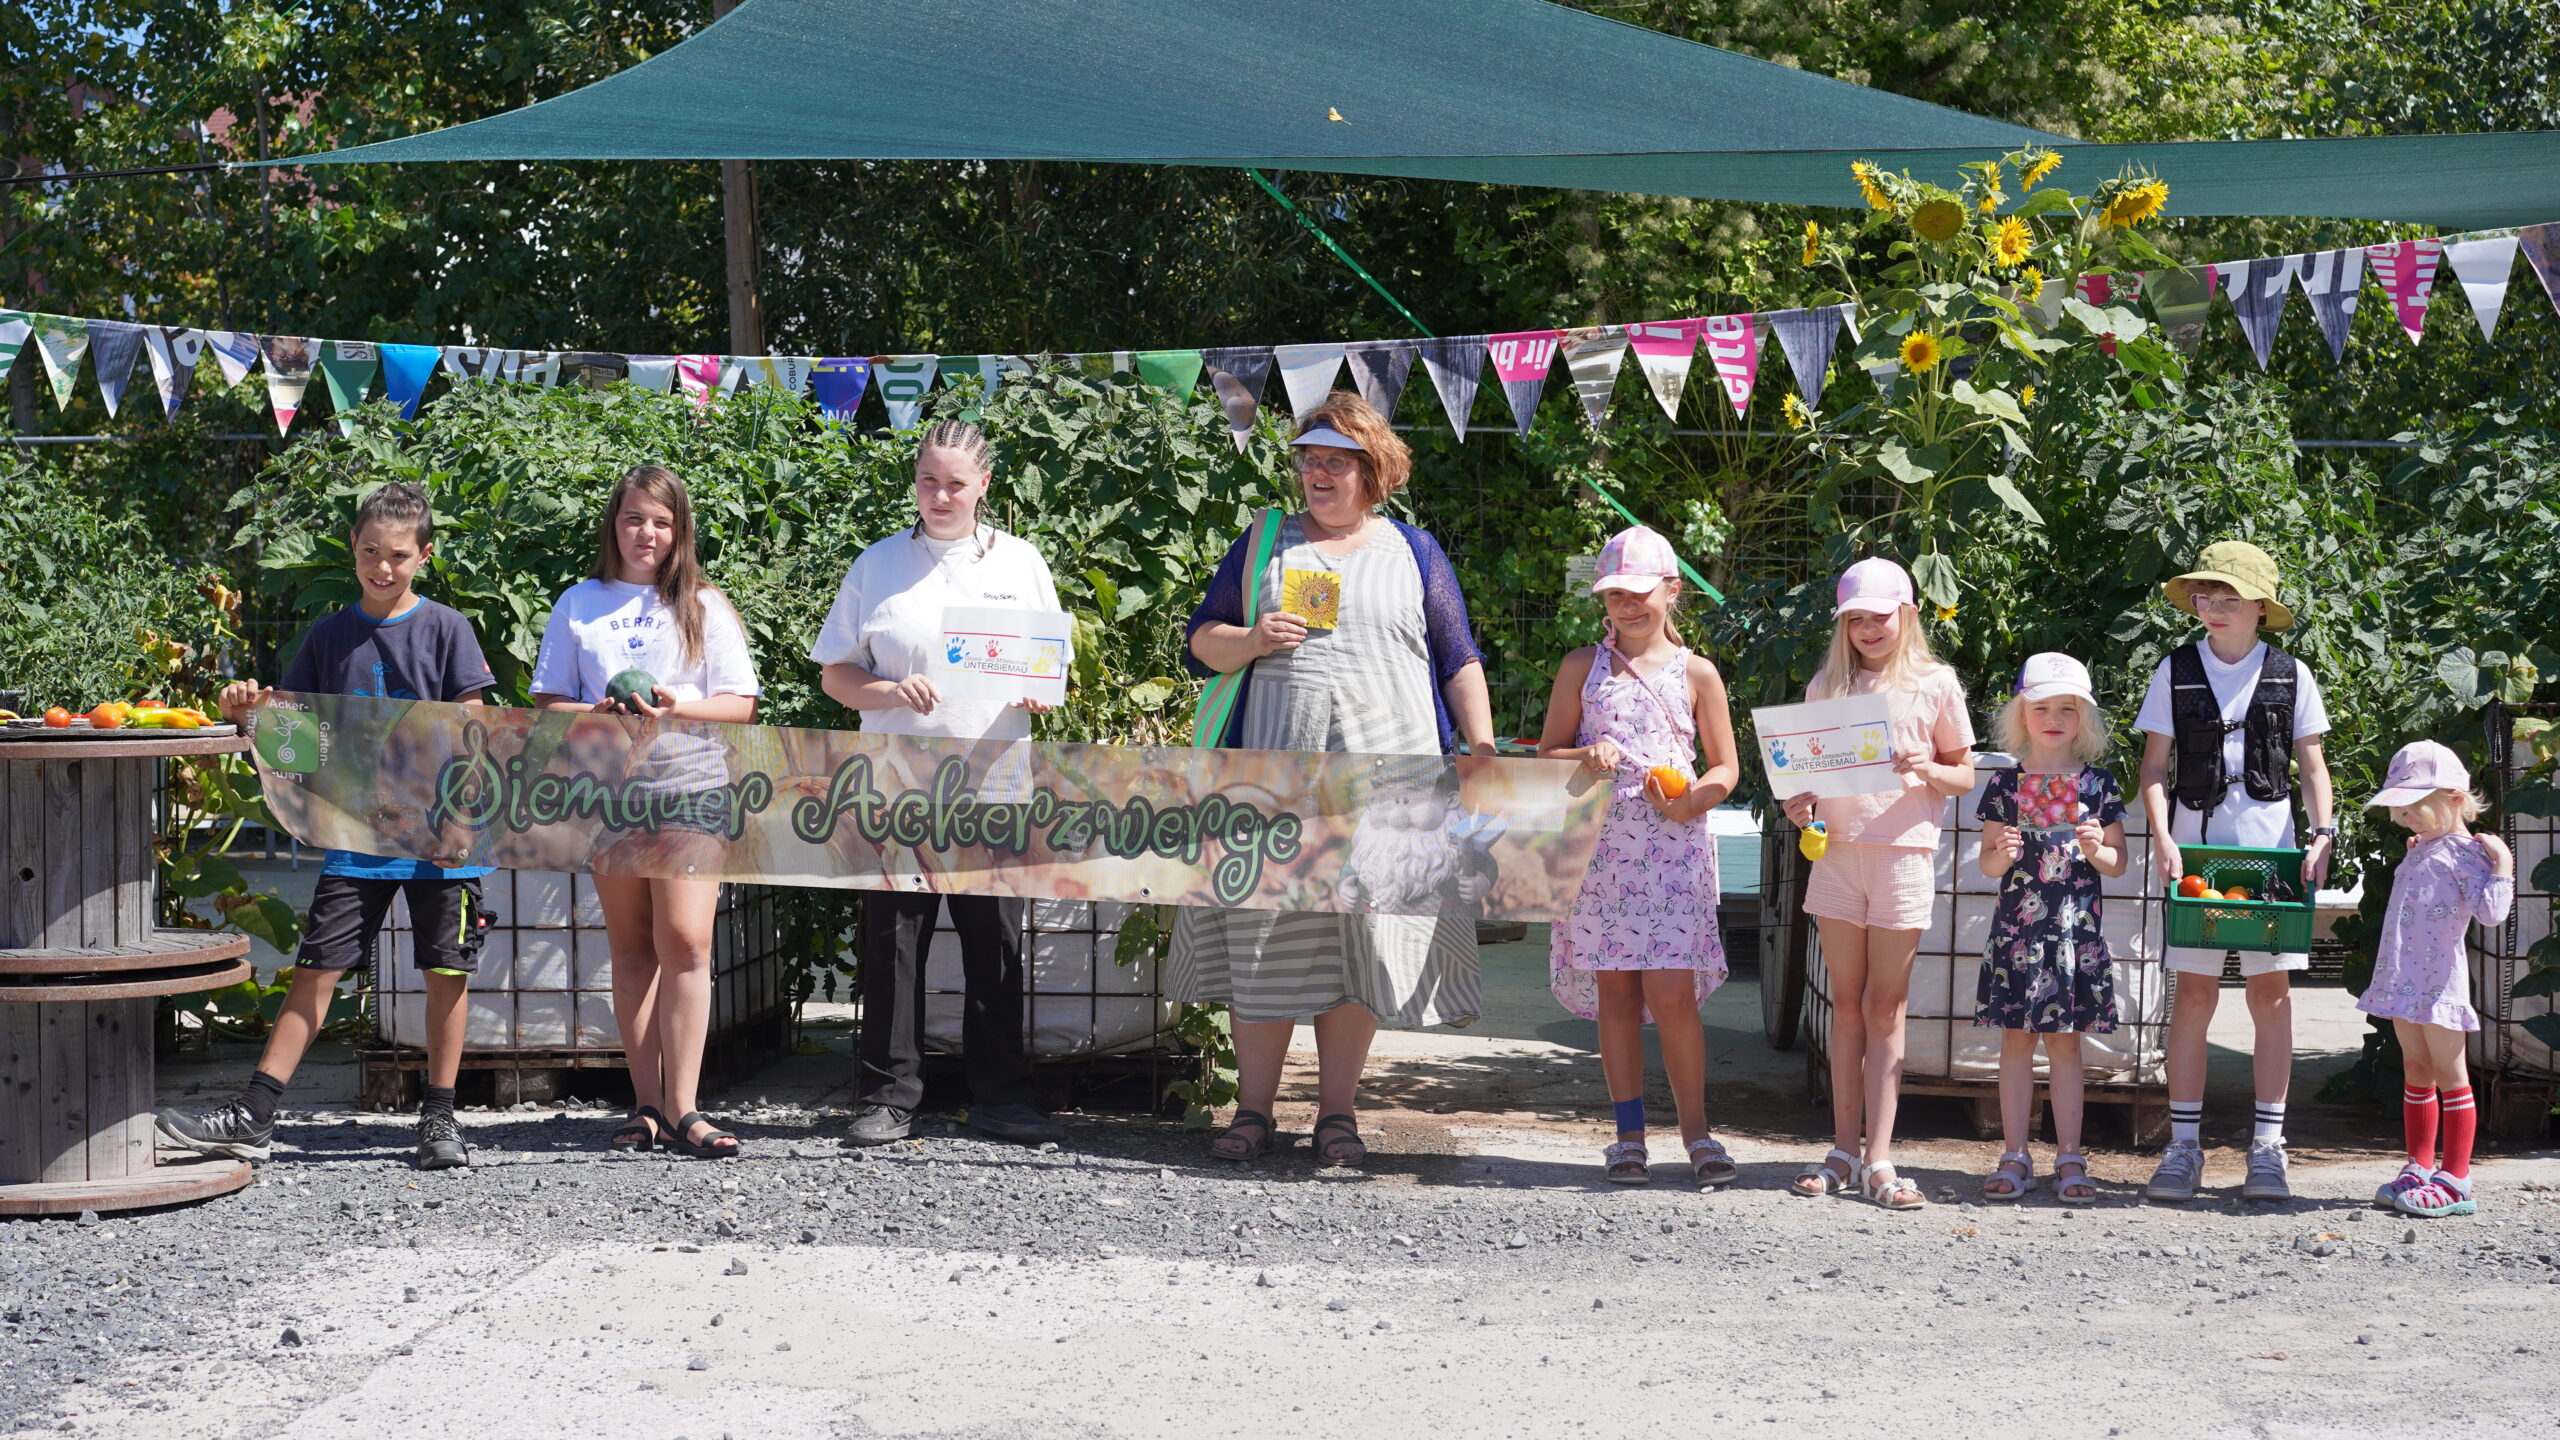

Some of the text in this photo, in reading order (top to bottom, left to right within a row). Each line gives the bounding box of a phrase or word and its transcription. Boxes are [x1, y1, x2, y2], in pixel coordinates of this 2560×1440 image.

[610, 616, 666, 630] BERRY
[963, 661, 1028, 674] UNTERSIEMAU
[269, 699, 309, 711] Acker-
[320, 721, 330, 767] Garten-
[1791, 756, 1857, 771] UNTERSIEMAU
[272, 771, 303, 783] Lern-
[426, 720, 1303, 906] Siemauer Ackerzwerge
